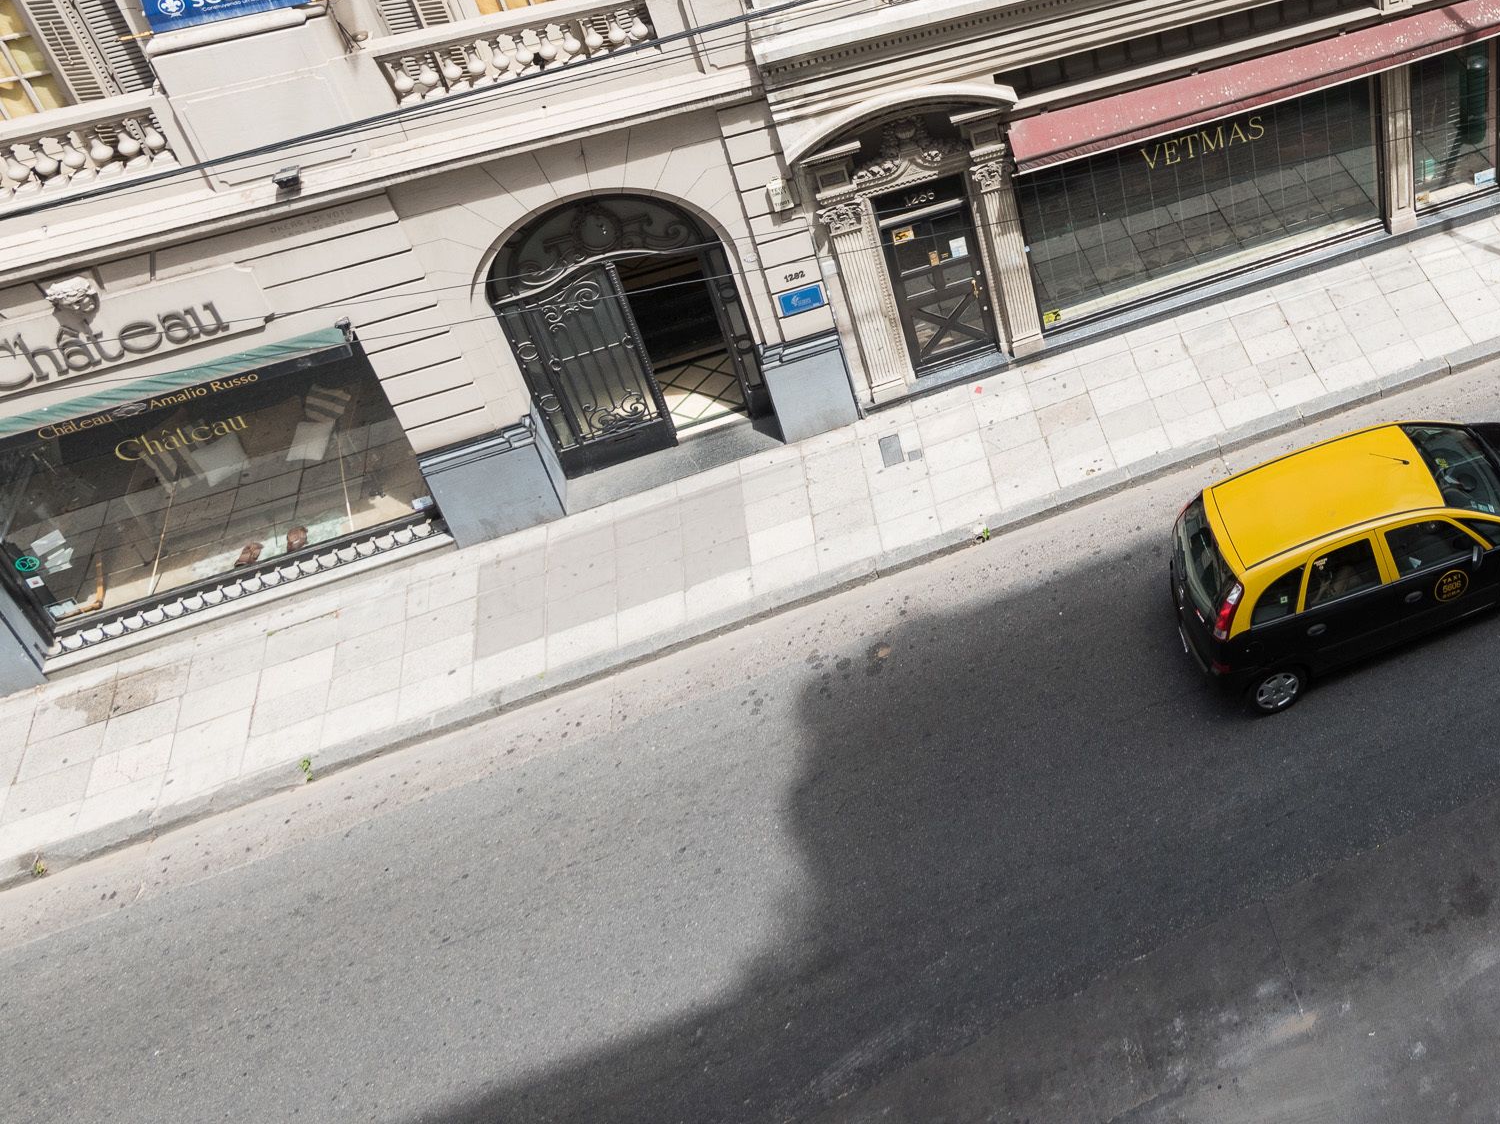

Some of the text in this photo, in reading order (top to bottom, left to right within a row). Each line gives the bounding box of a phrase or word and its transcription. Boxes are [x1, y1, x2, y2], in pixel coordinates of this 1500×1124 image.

[1140, 116, 1265, 169] VETMAS
[784, 270, 806, 283] 1282
[38, 373, 259, 439] Château Amalio Russo
[114, 414, 248, 462] Château
[1442, 573, 1461, 584] TAXI
